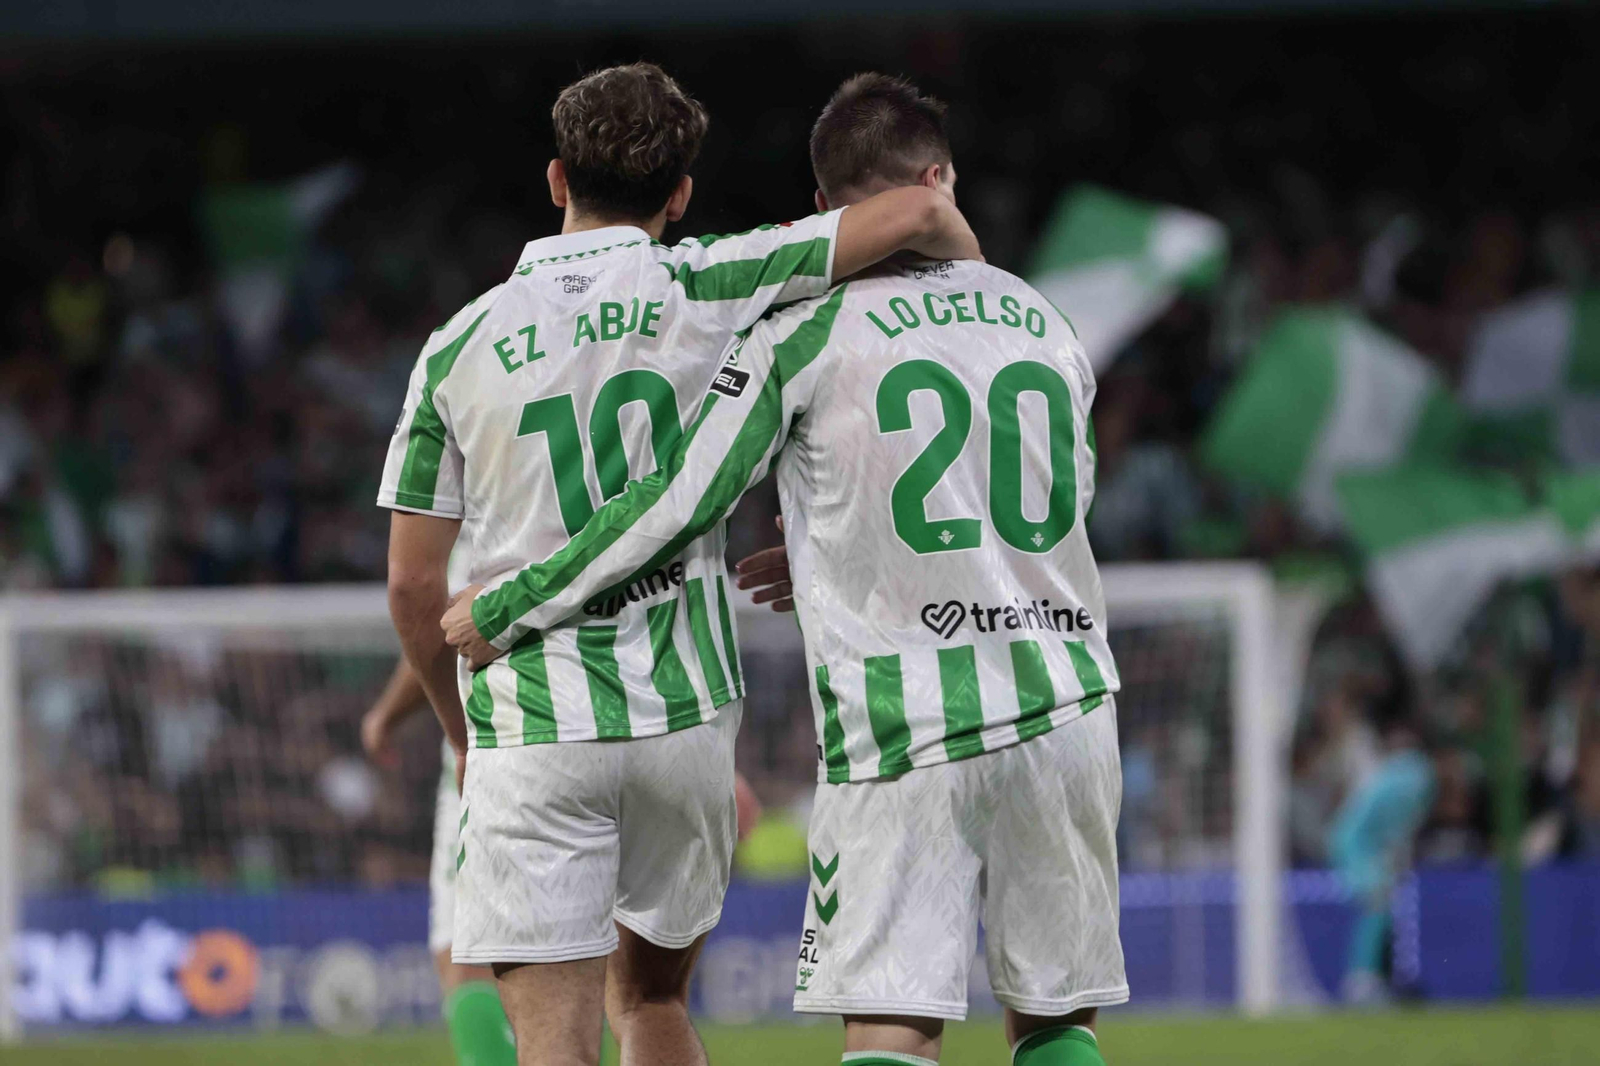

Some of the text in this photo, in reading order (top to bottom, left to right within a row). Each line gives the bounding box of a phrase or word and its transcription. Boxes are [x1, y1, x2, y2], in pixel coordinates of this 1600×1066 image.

[492, 323, 546, 374] EZ
[515, 368, 683, 540] 10
[875, 358, 1077, 555] 20
[970, 597, 1094, 633] trainline
